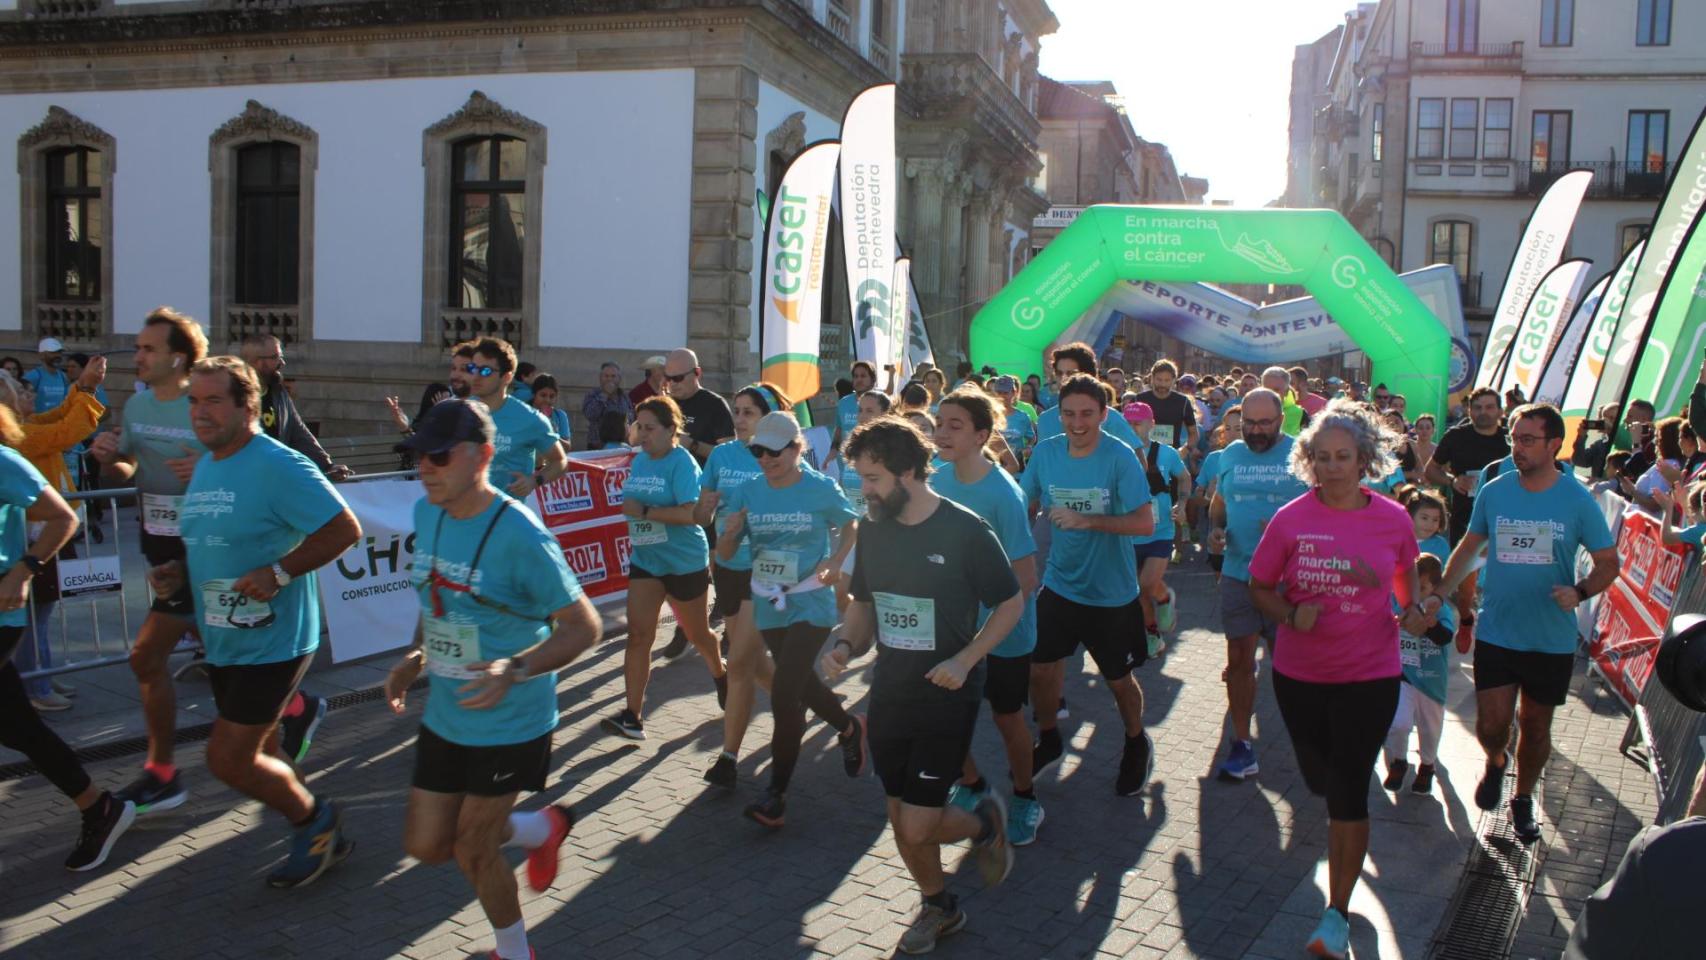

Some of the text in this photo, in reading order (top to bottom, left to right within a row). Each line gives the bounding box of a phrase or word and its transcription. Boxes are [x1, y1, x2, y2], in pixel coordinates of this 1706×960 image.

[851, 164, 868, 269] Deputación
[868, 164, 882, 269] Pontevedra
[1126, 215, 1218, 230] En marcha
[774, 185, 807, 295] caser
[1124, 232, 1181, 245] contra
[1124, 248, 1205, 263] el cáncer
[1506, 229, 1545, 316] Deputación
[1518, 284, 1559, 365] caser
[1234, 464, 1246, 473] En
[541, 471, 588, 502] FROIZ
[1065, 500, 1092, 512] 1476
[747, 511, 812, 523] En marcha
[635, 522, 652, 532] 799
[1299, 541, 1314, 553] En
[1511, 537, 1536, 548] 257
[563, 543, 603, 574] ROIZ
[1299, 556, 1351, 570] marcha
[760, 563, 786, 575] 1177
[1298, 570, 1340, 583] contra
[64, 571, 118, 587] GESMAGAL
[884, 612, 918, 629] 1936
